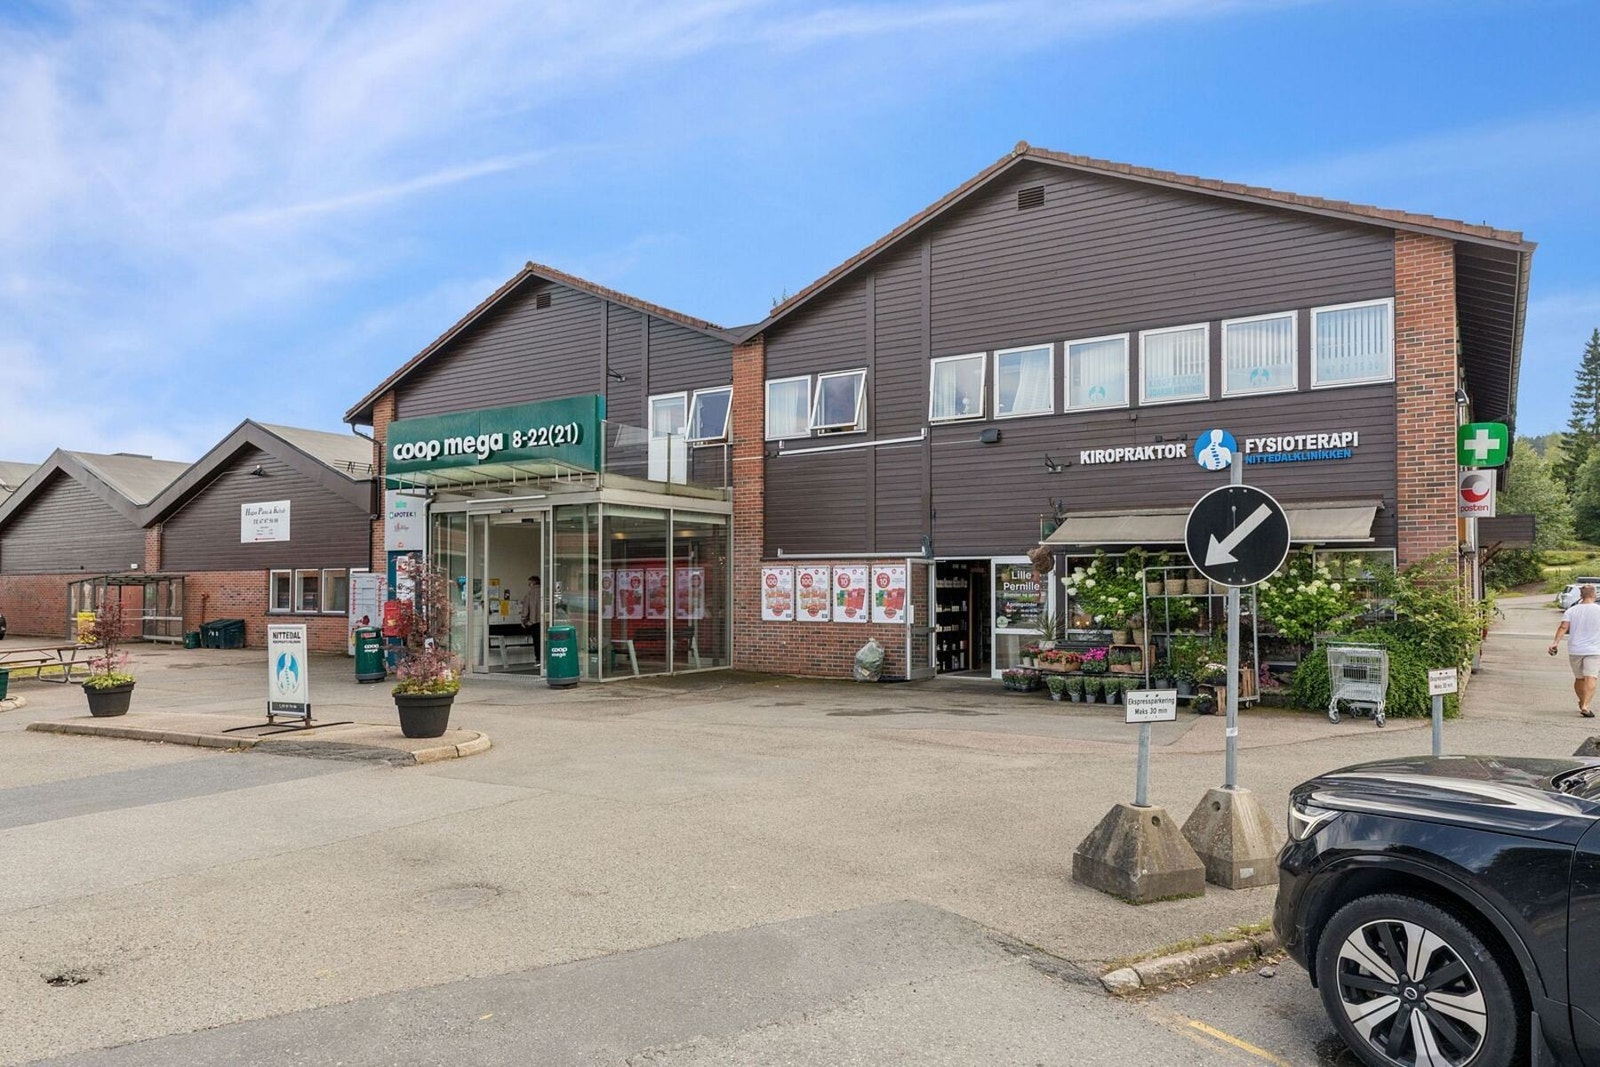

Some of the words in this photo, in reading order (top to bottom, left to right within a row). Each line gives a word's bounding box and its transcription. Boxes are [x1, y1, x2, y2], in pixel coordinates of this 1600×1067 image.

[393, 440, 440, 461] coop
[444, 433, 503, 459] mega
[512, 422, 579, 448] 8-22(21)
[1245, 431, 1359, 454] FYSIOTERAPI
[1080, 443, 1187, 465] KIROPRAKTOR
[1245, 449, 1351, 464] NITTEDALKLINIKKEN
[1461, 504, 1489, 513] posten
[1011, 570, 1032, 580] Lille
[1003, 582, 1040, 591] Pernille
[272, 631, 301, 639] NITTEDAL
[1128, 697, 1175, 706] Ekspressparkering
